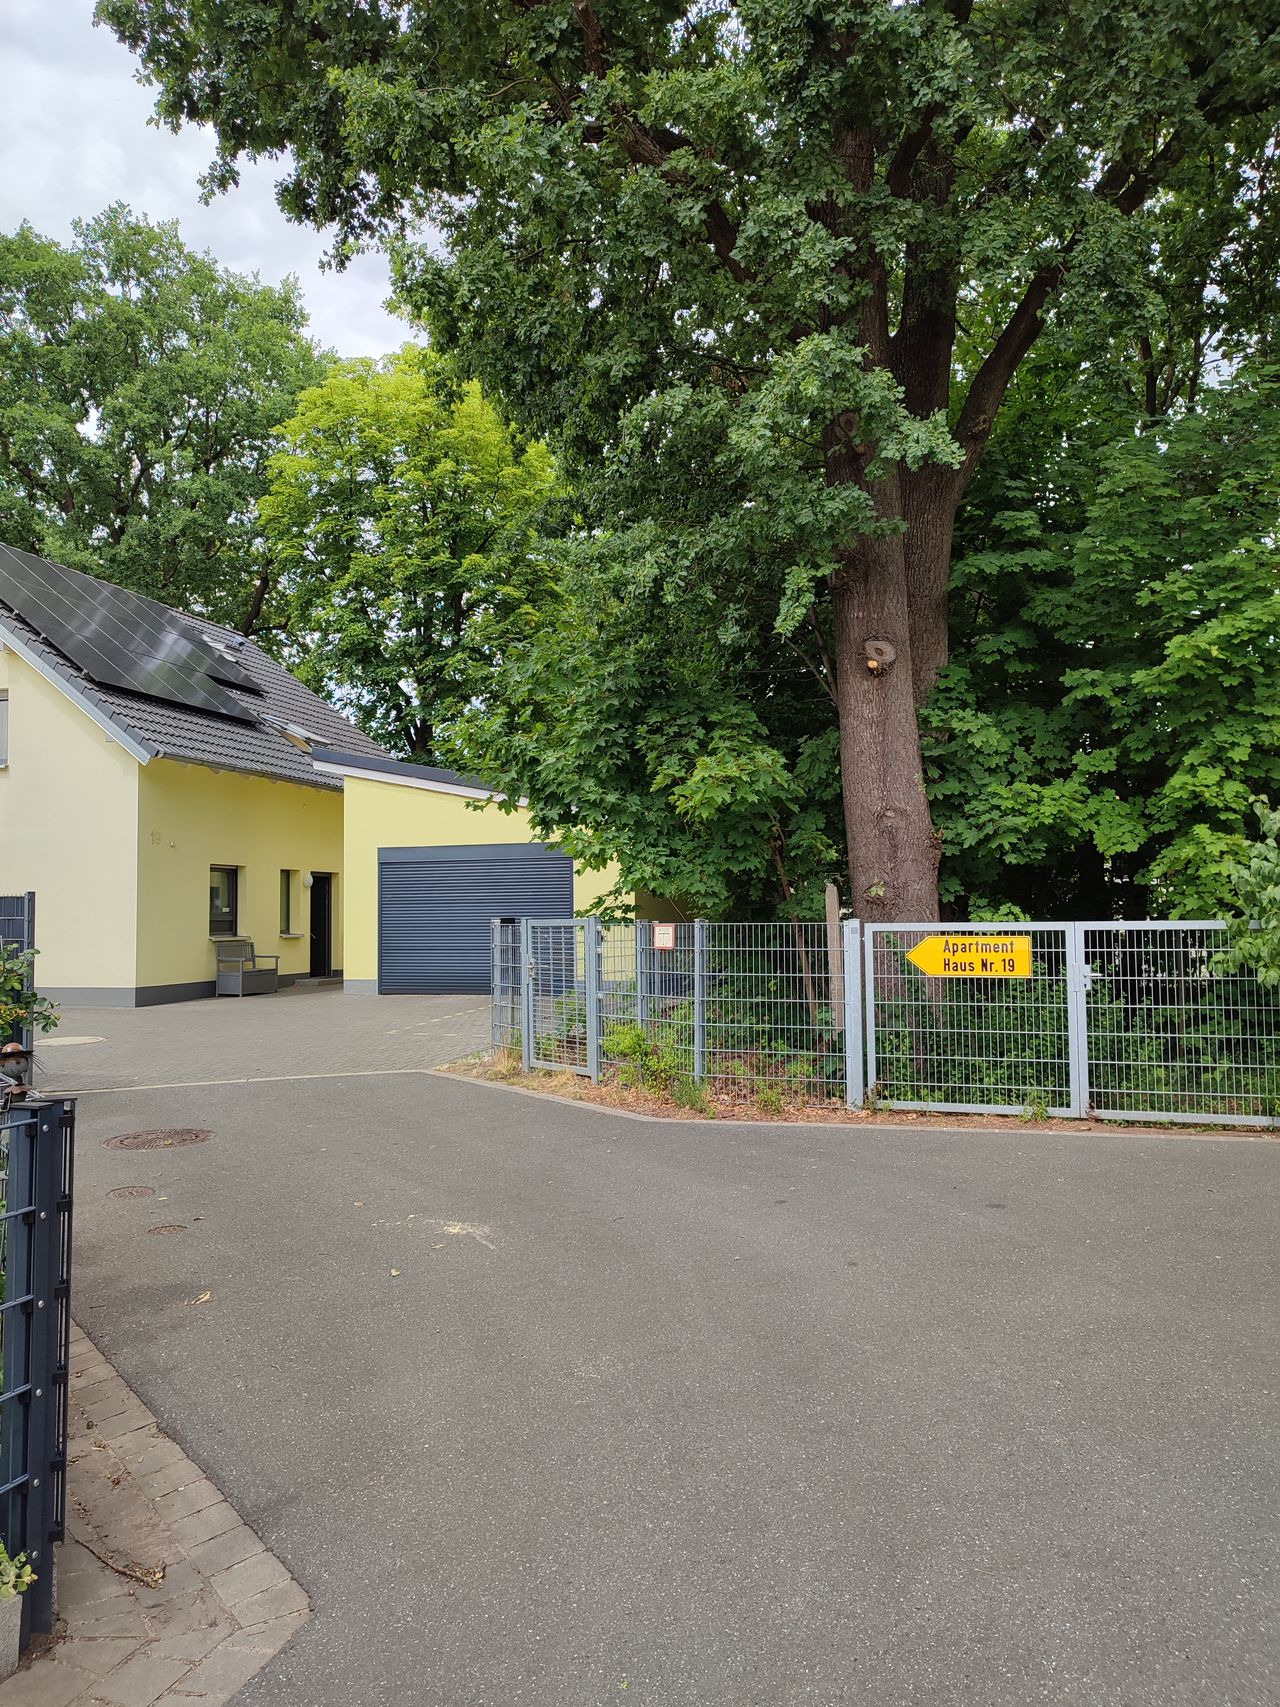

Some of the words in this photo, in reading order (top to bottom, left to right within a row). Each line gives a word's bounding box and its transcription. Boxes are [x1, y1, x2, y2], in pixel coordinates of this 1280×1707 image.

[150, 831, 161, 846] 19
[943, 939, 1015, 956] Apartment
[943, 958, 975, 972] Haus
[981, 958, 998, 972] Nr.
[1001, 958, 1015, 972] 19
